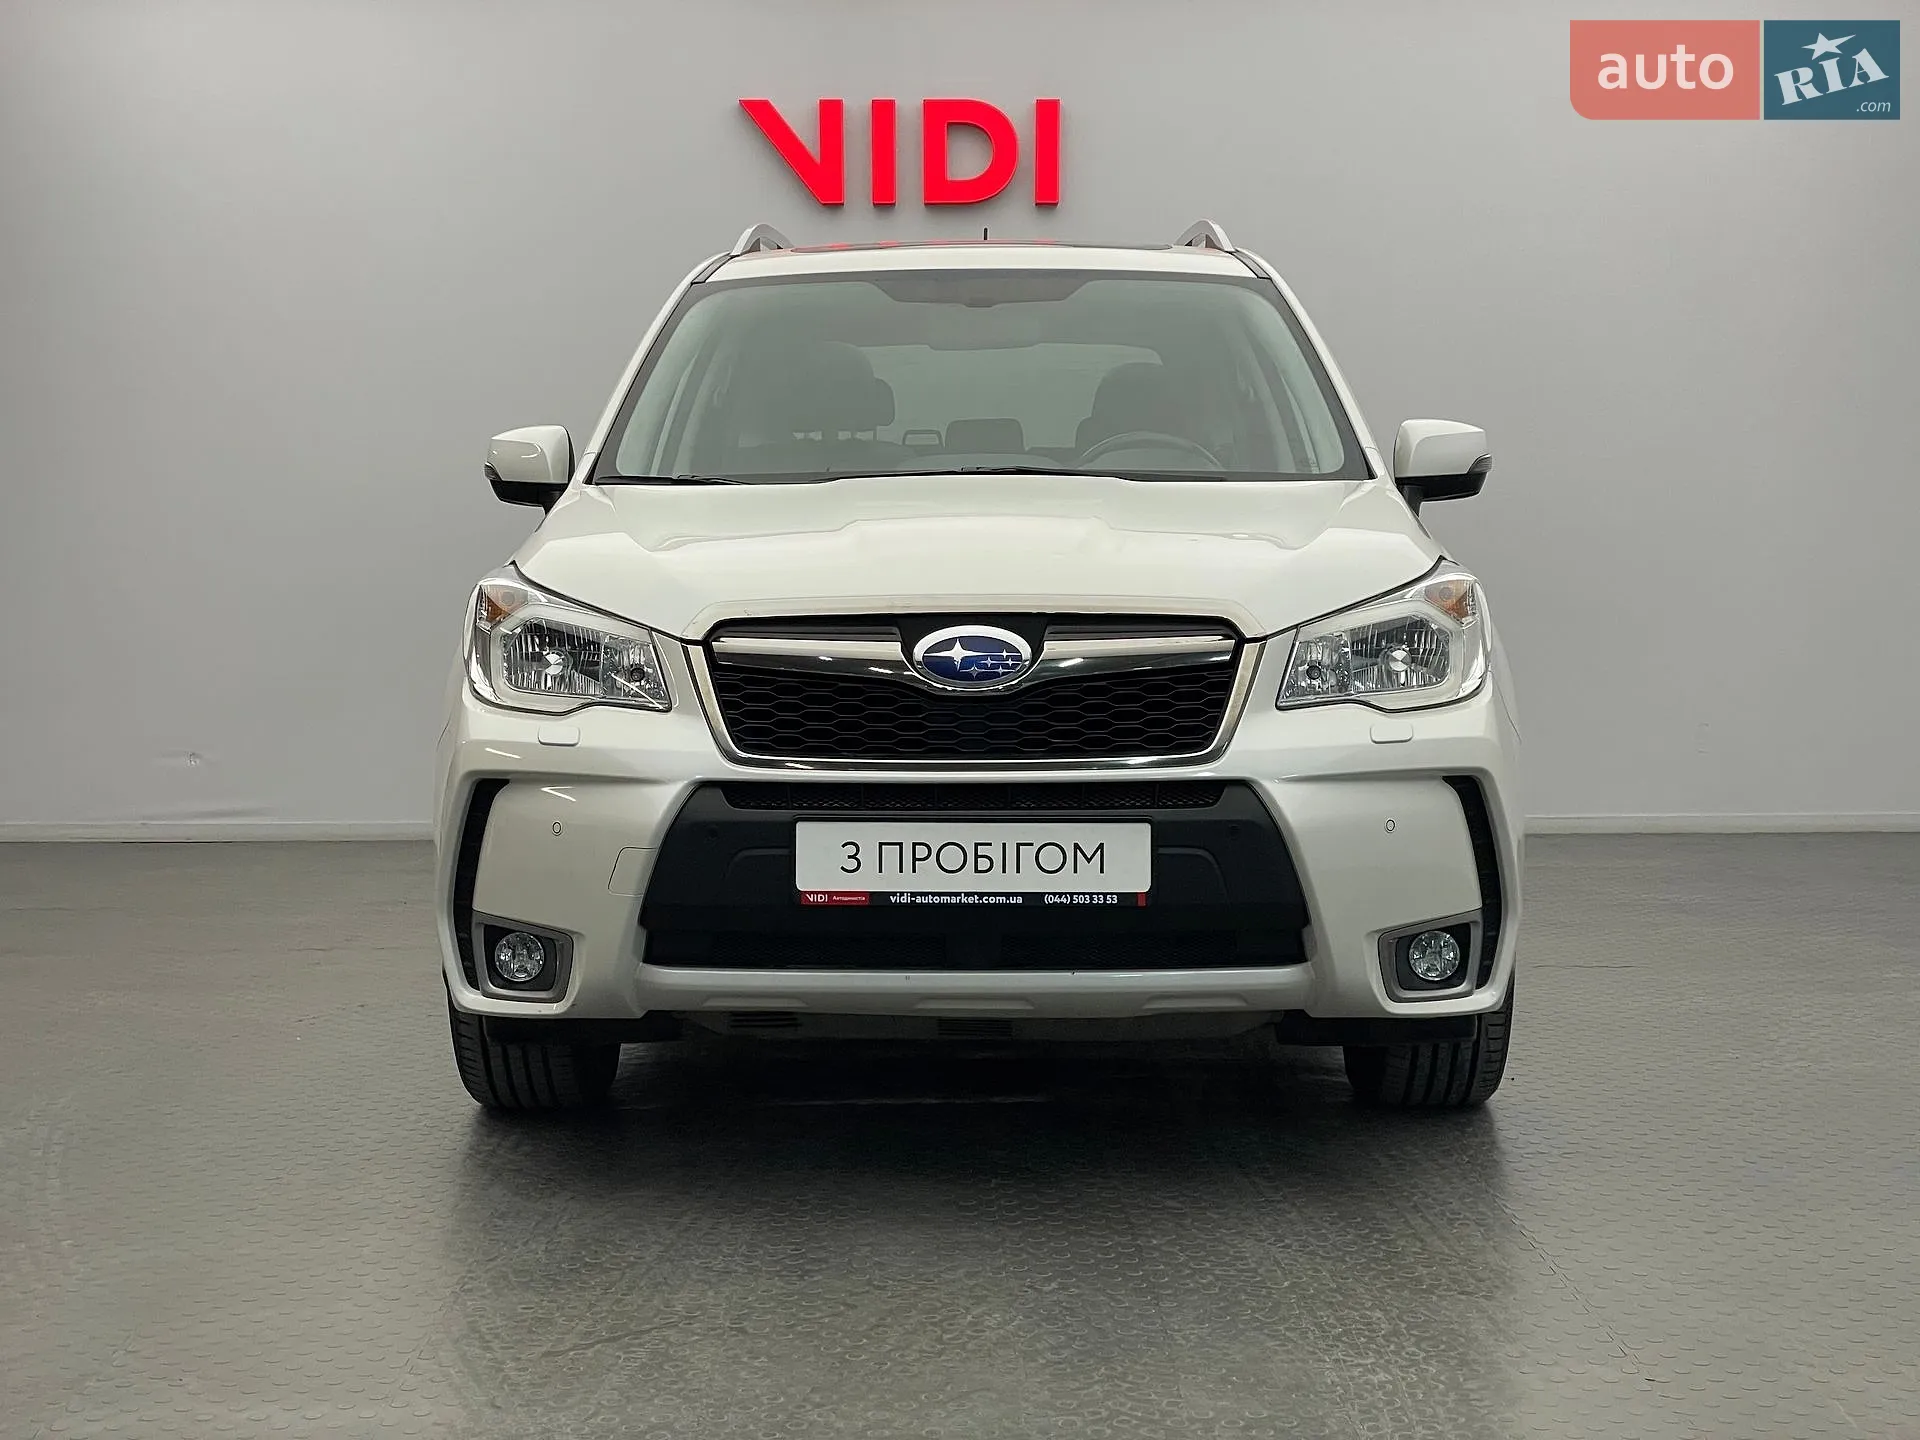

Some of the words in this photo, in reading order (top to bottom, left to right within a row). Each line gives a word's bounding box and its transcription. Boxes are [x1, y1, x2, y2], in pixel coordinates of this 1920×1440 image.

[738, 98, 1061, 206] VIDI
[878, 841, 1105, 875] ПРОБІГОМ
[806, 893, 828, 902] VIDI
[889, 893, 1023, 904] vidi-automarket.com.ua
[1044, 894, 1071, 905] (044)
[1072, 894, 1090, 904] 503
[1092, 894, 1104, 904] 33
[1106, 894, 1118, 904] 53
